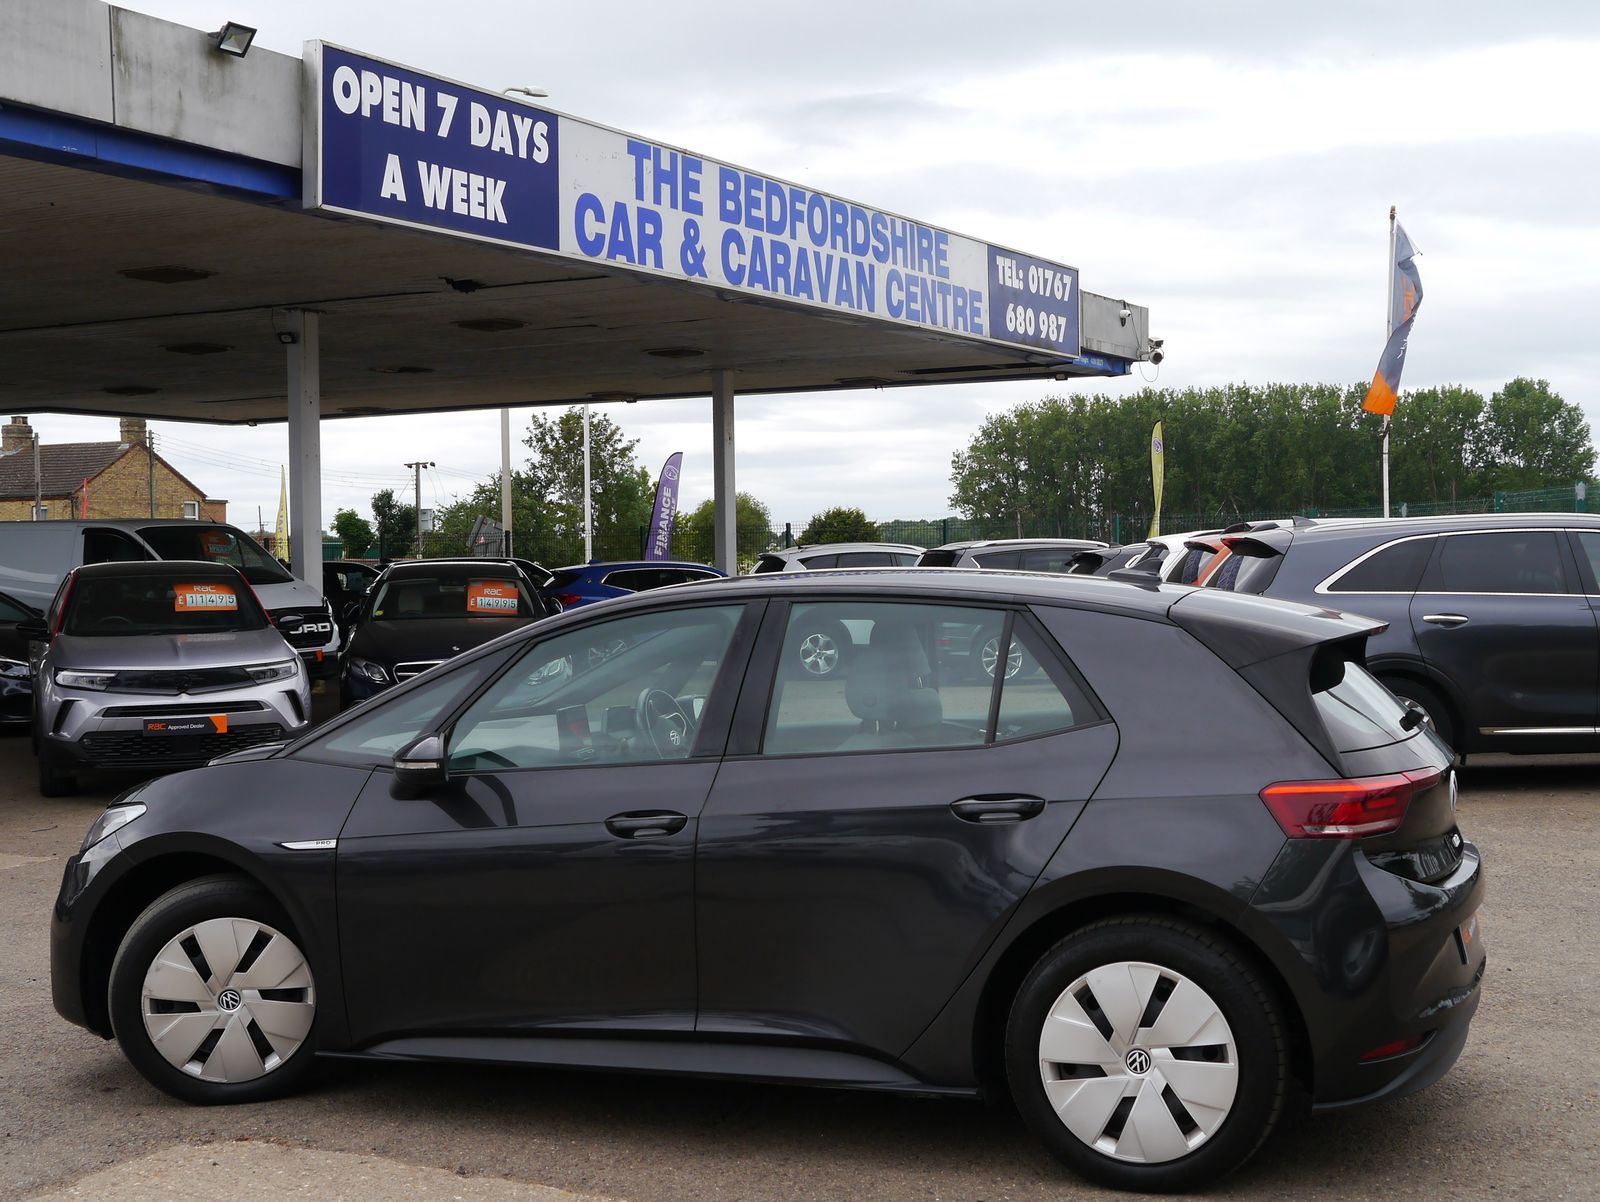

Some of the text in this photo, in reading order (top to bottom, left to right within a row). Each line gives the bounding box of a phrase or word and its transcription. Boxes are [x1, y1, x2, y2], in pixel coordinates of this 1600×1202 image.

[333, 65, 549, 164] OPEN 7 DAYS
[380, 153, 507, 224] A WEEK
[627, 138, 950, 280] THE BEDFORDSHIRE
[574, 192, 984, 335] CAR & CARAVAN CENTRE
[996, 255, 1072, 302] TEL: 01767
[1006, 303, 1066, 343] 680 987
[654, 486, 672, 556] FINANCE
